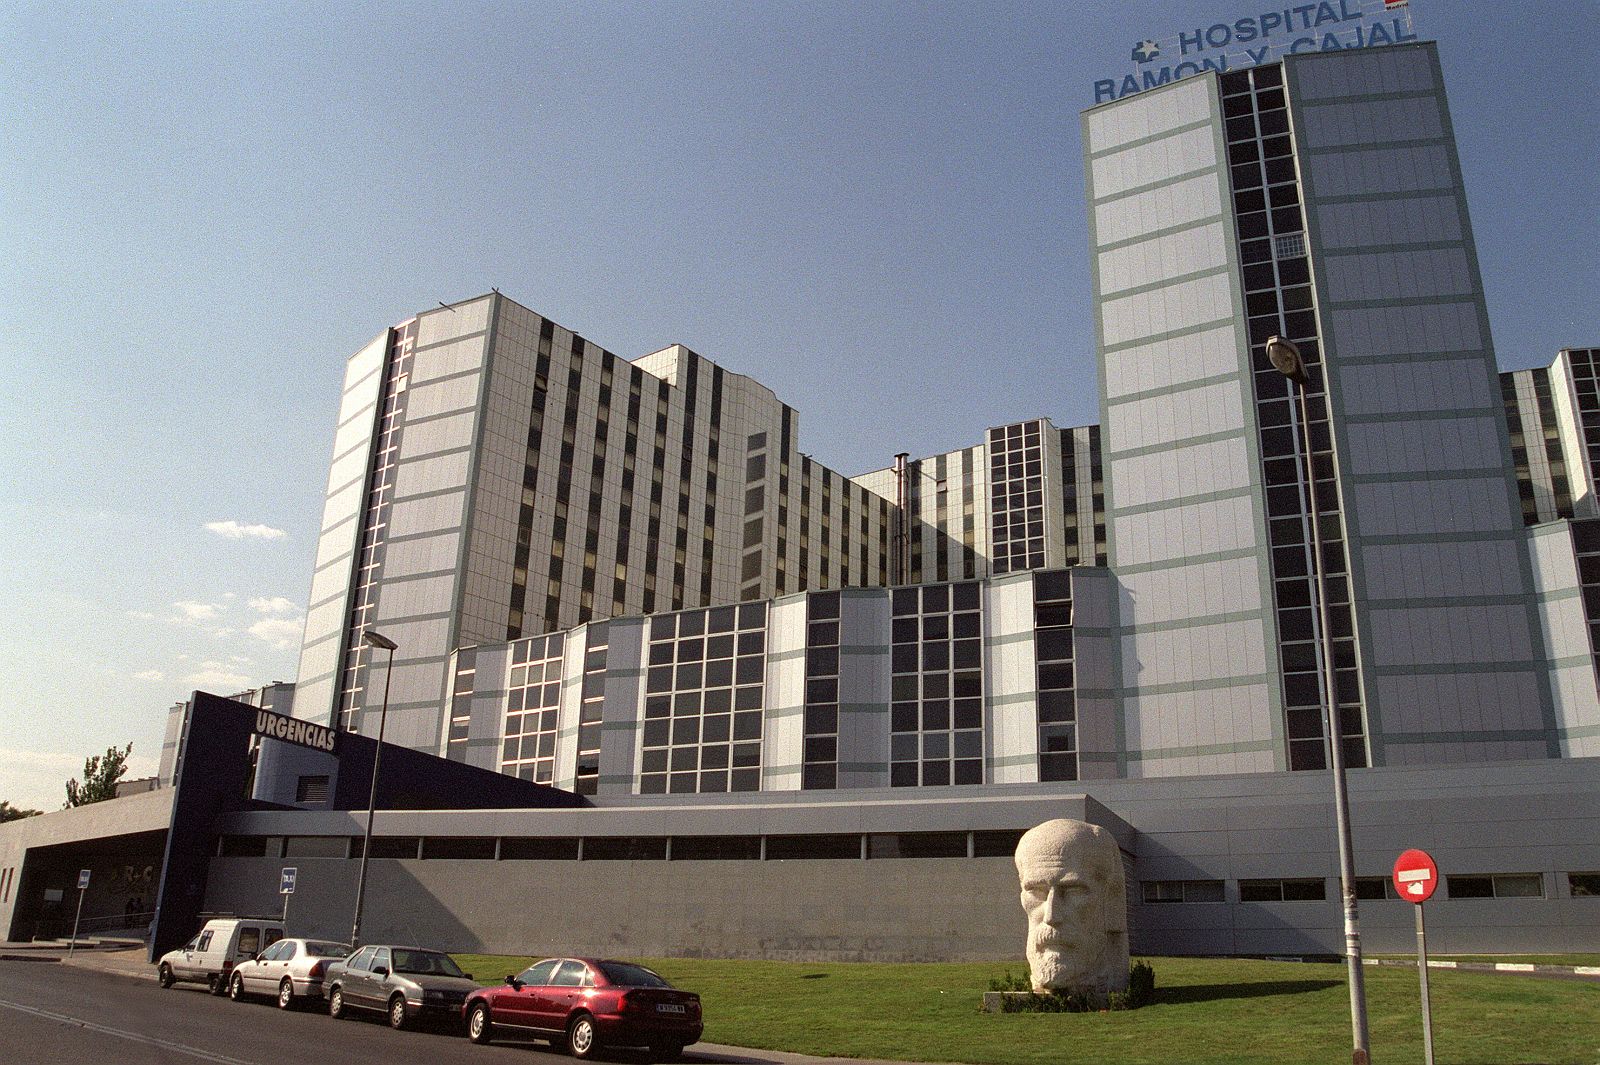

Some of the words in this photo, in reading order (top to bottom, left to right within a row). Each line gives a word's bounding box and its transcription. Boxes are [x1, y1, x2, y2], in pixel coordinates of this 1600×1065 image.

[1179, 0, 1363, 54] HOSPITAL
[1245, 45, 1270, 66] Y
[1289, 19, 1417, 55] CAJAL
[256, 711, 336, 751] URGENCIAS
